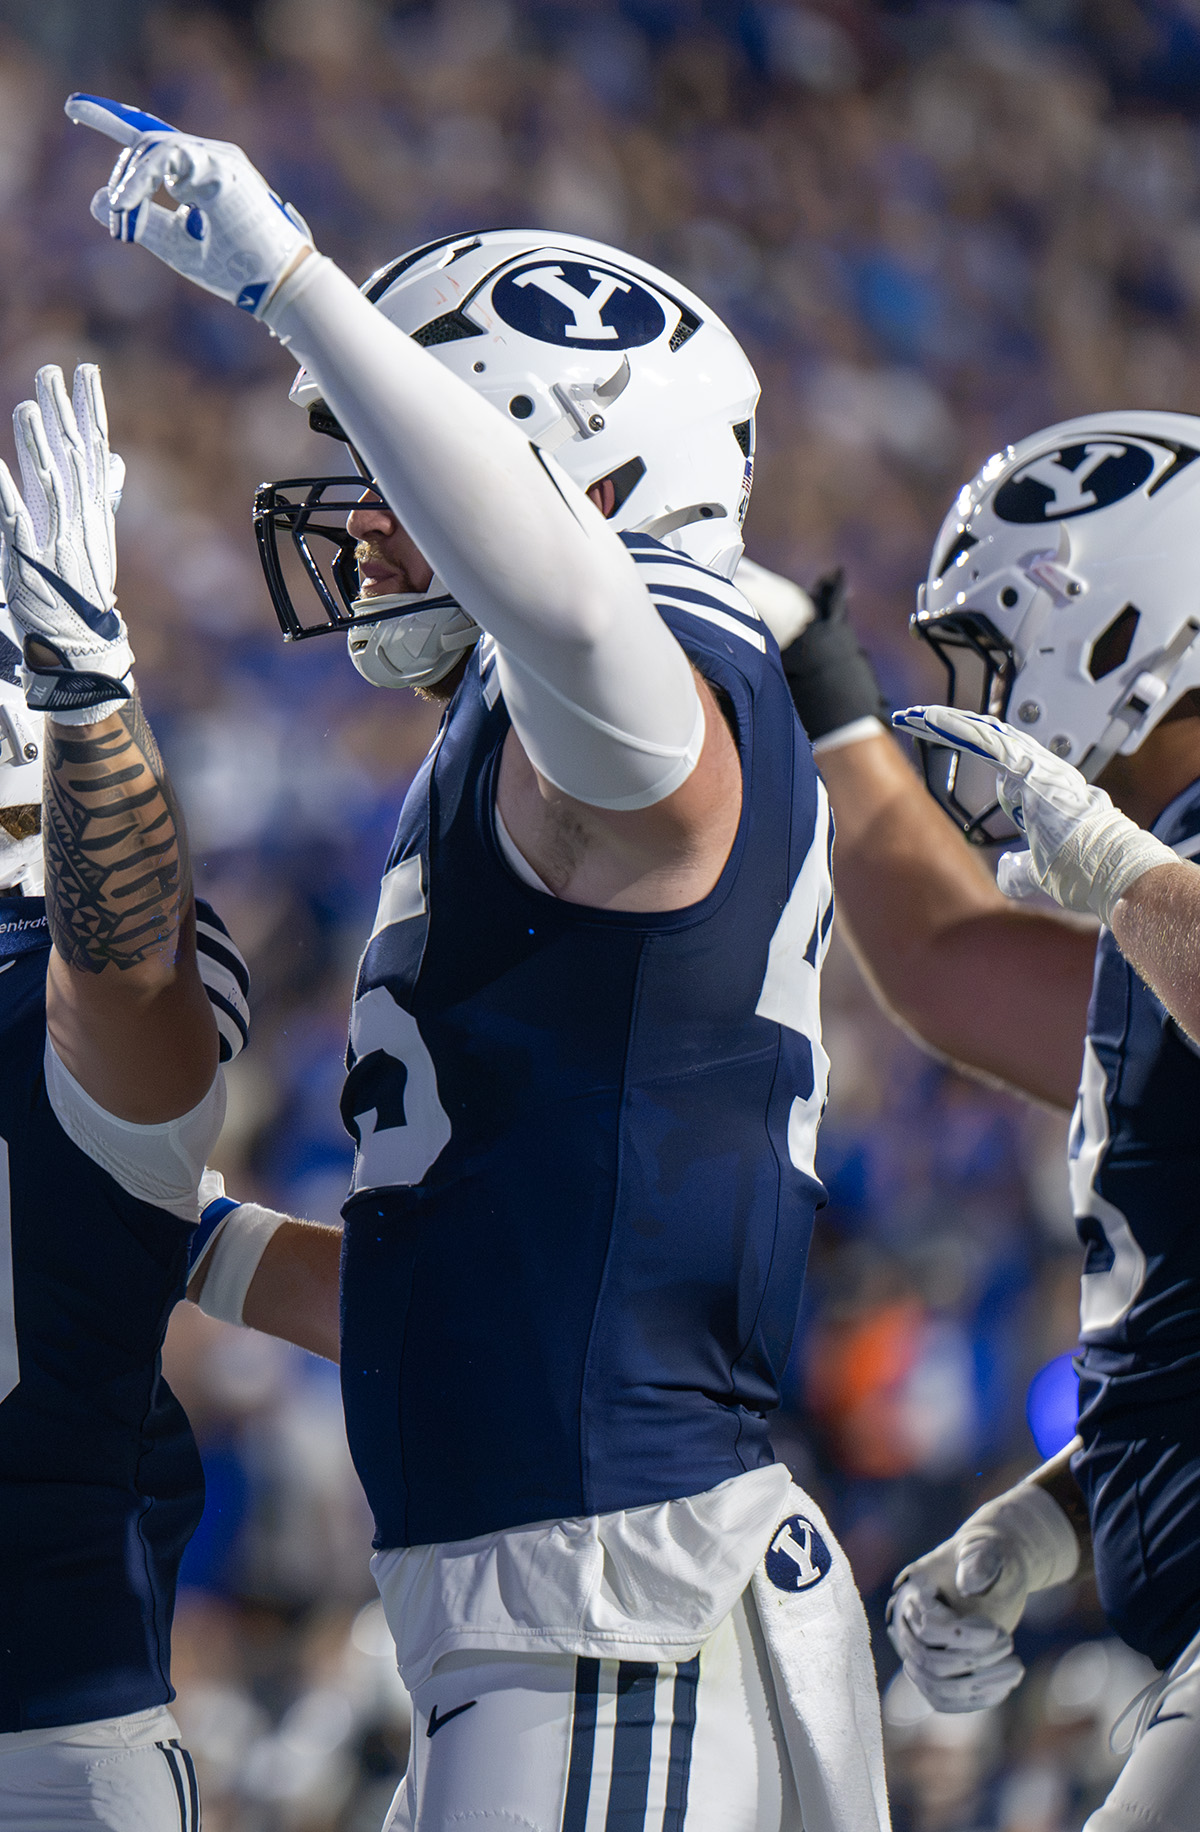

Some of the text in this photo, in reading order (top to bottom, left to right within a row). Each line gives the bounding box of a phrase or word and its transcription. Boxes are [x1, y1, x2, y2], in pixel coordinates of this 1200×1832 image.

[511, 265, 632, 340] Y
[1012, 443, 1128, 518] Y
[770, 1518, 821, 1587] Y
